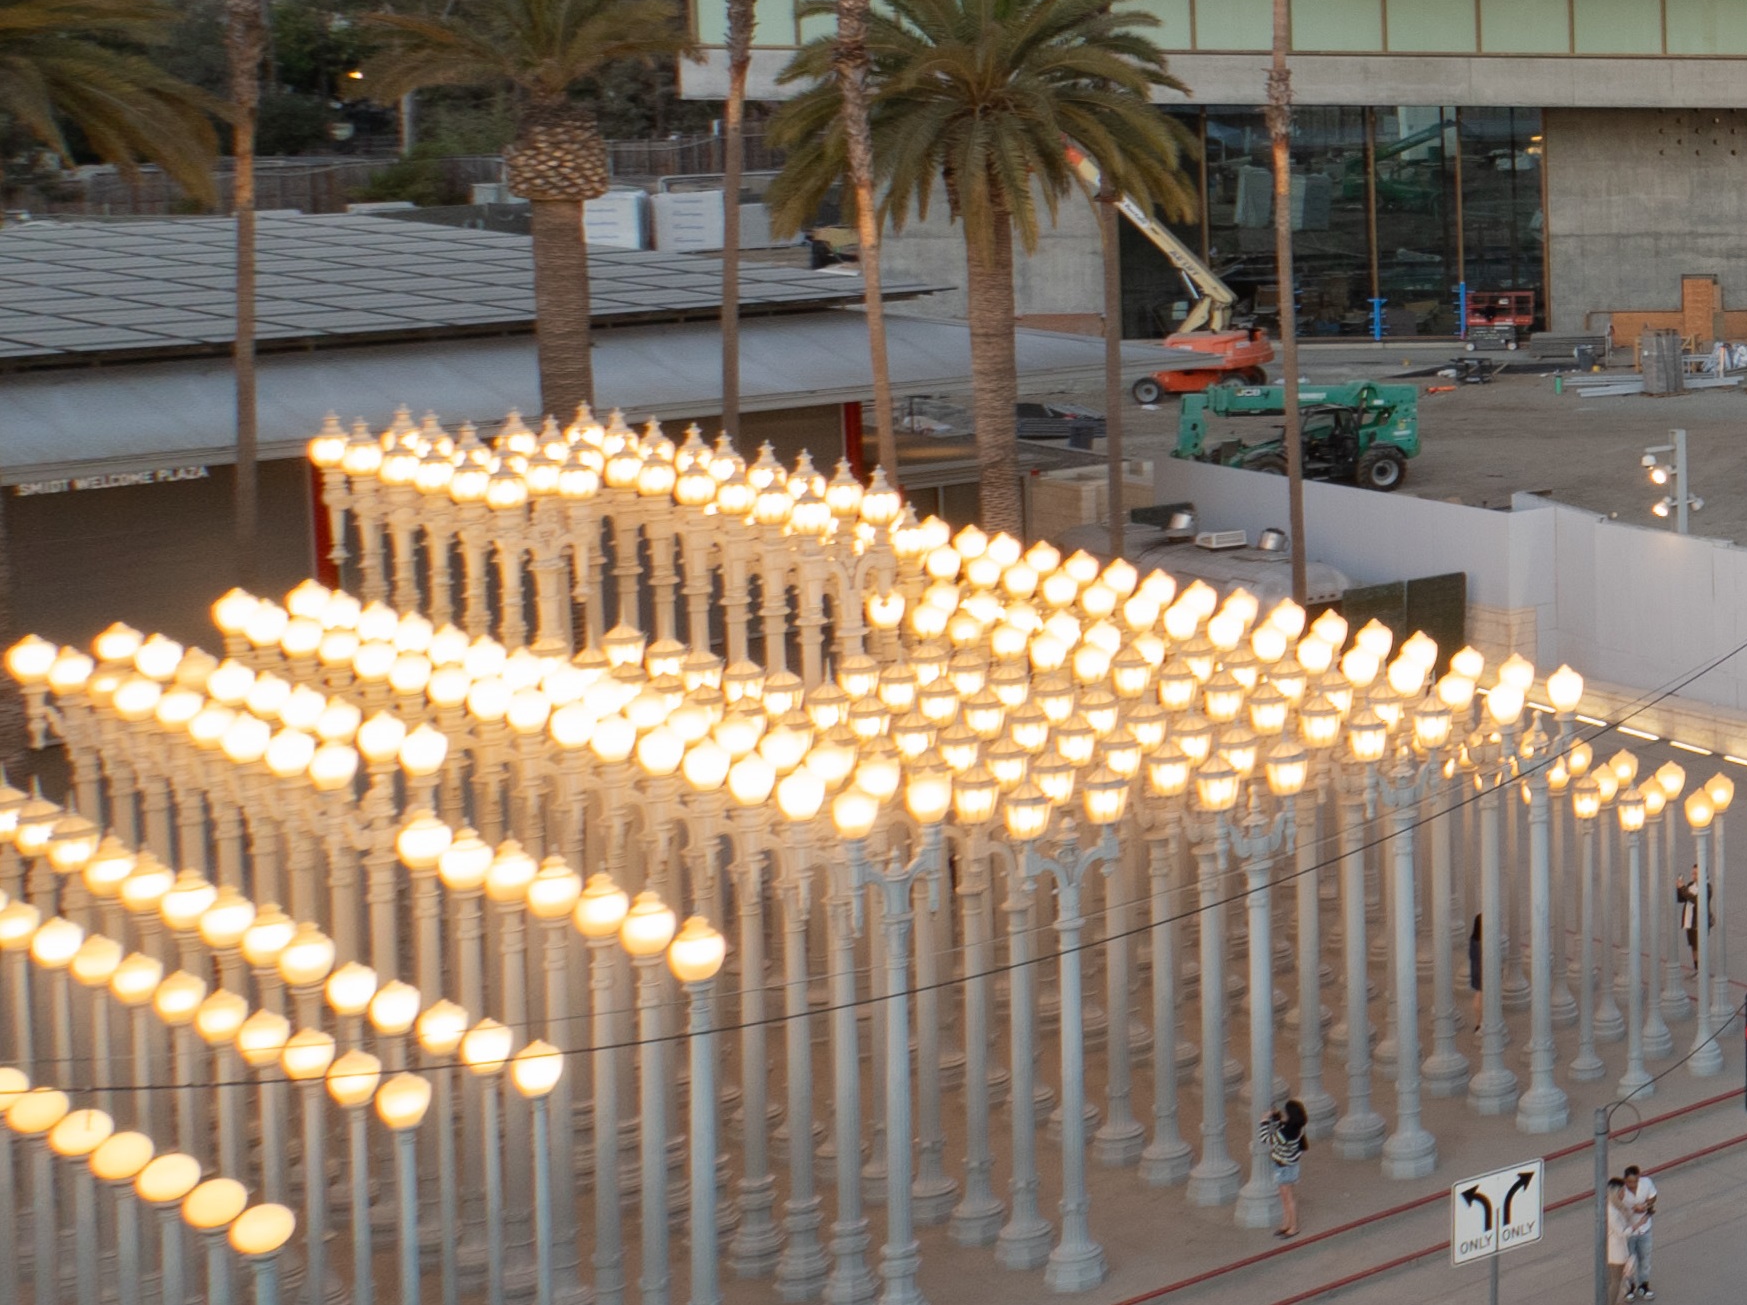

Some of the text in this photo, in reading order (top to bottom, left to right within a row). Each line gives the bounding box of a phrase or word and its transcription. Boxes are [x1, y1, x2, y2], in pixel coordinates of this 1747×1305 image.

[75, 472, 154, 490] WELCOME
[157, 465, 210, 482] PLAZA
[1502, 1221, 1535, 1241] ONLY
[1461, 1234, 1493, 1254] ONLY
